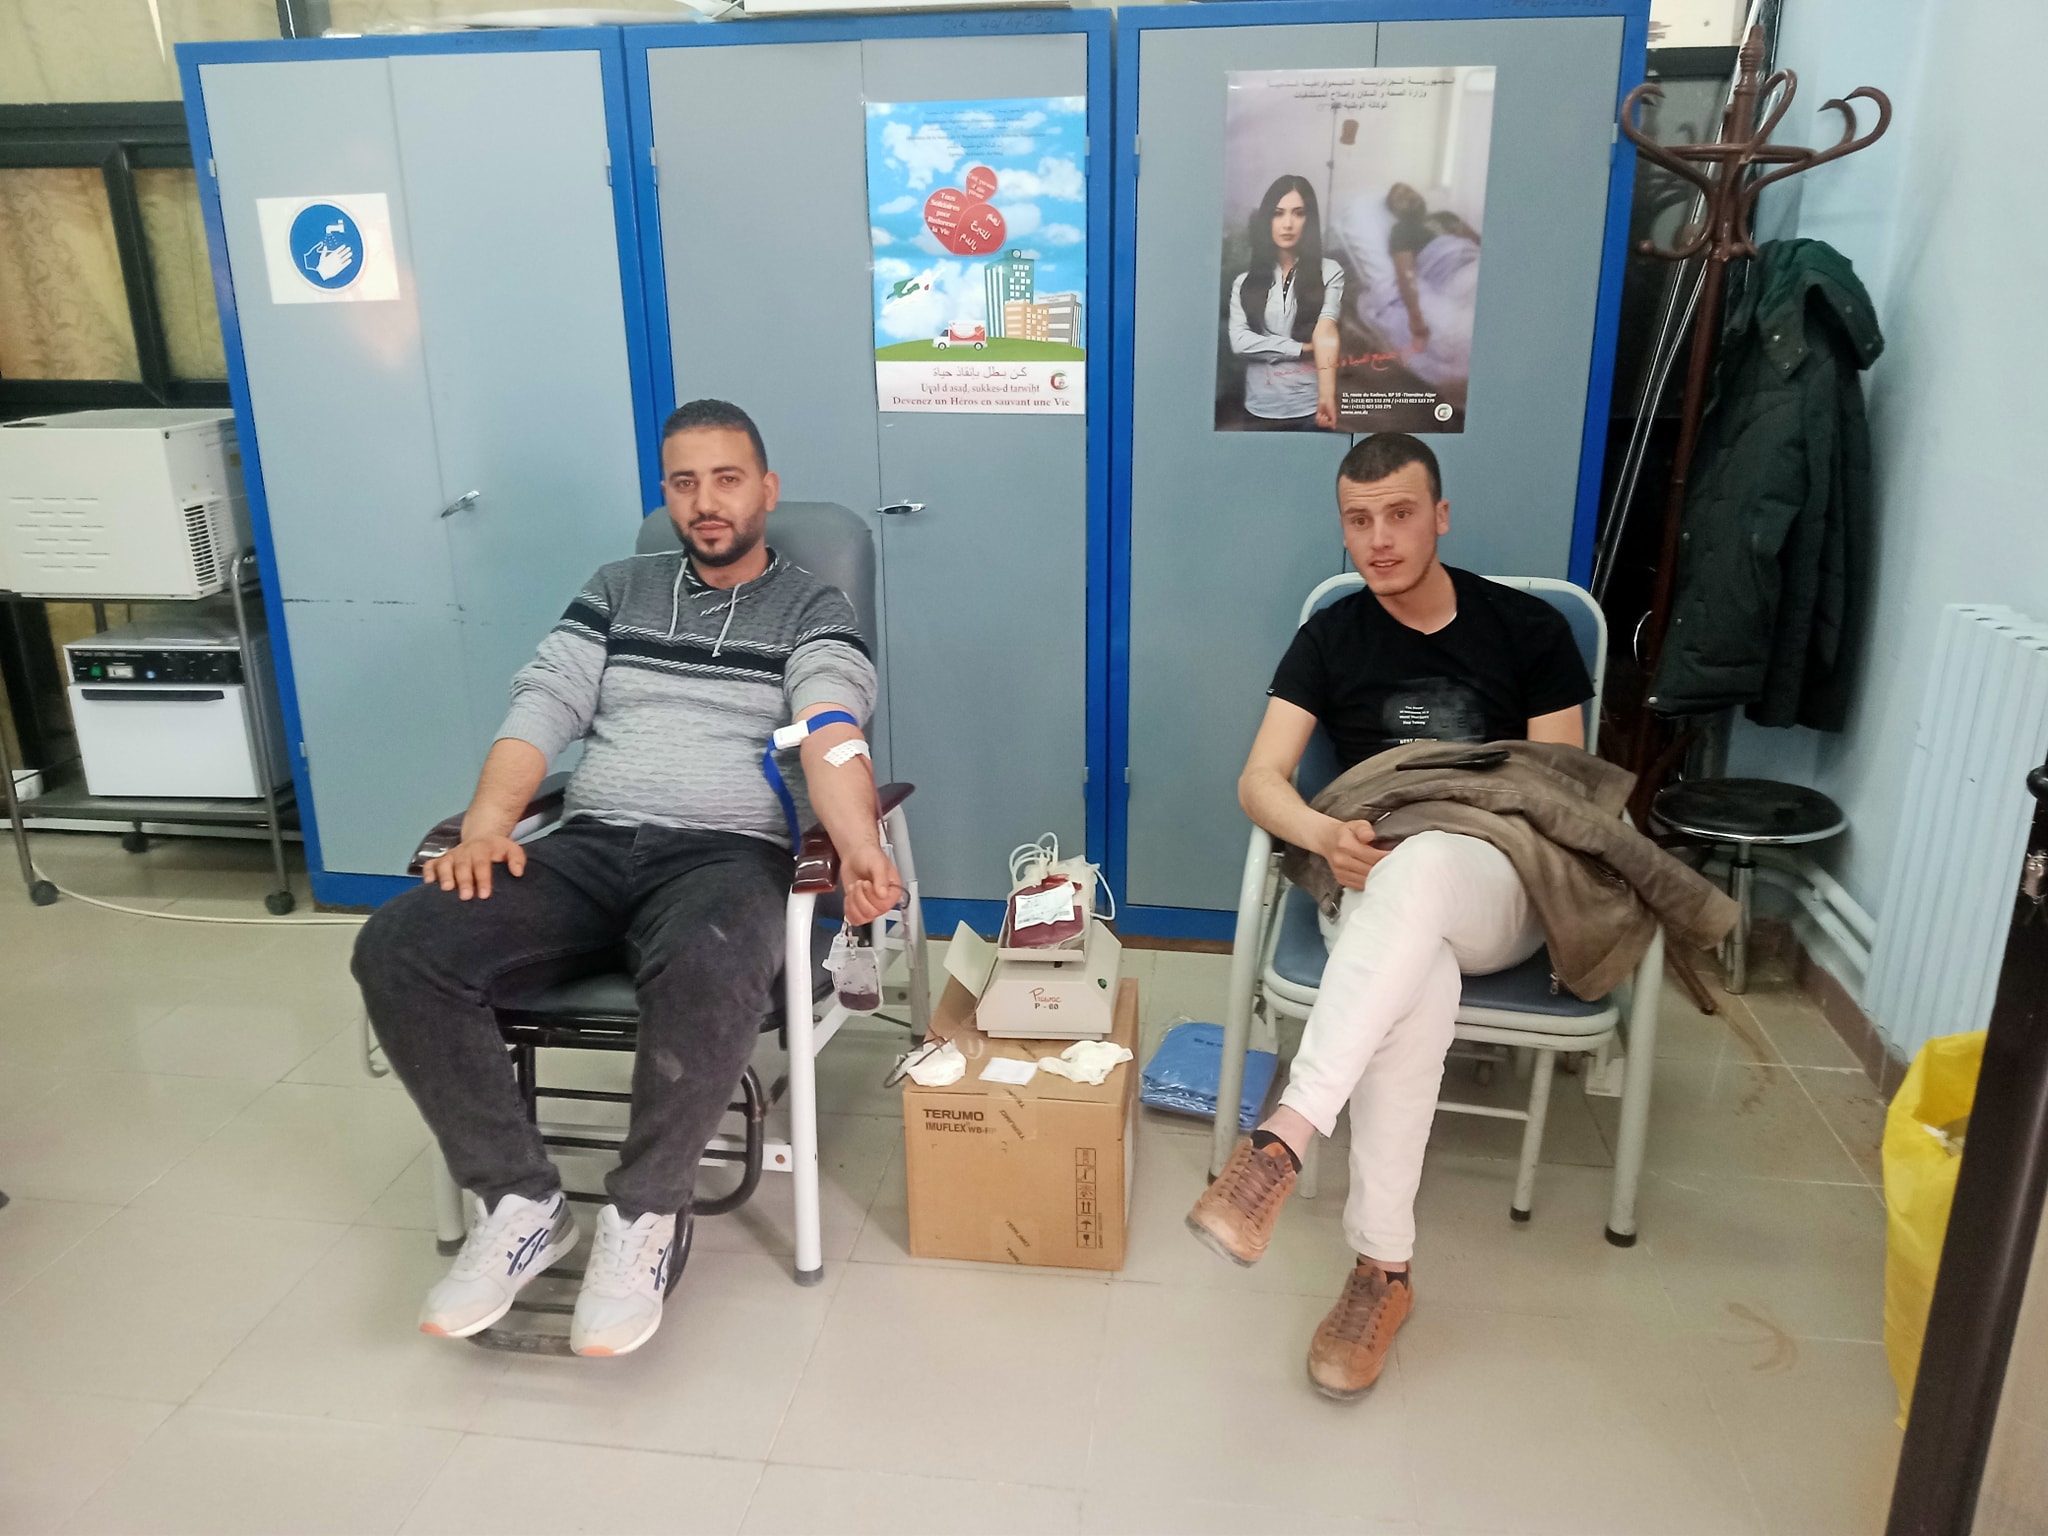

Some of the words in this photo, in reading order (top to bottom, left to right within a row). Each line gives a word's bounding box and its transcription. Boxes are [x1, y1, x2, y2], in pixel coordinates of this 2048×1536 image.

[1010, 366, 1028, 380] كن
[893, 396, 932, 405] Devenez
[995, 397, 1030, 406] sauvant
[1054, 398, 1070, 407] Vie
[922, 1109, 984, 1121] TERUMO
